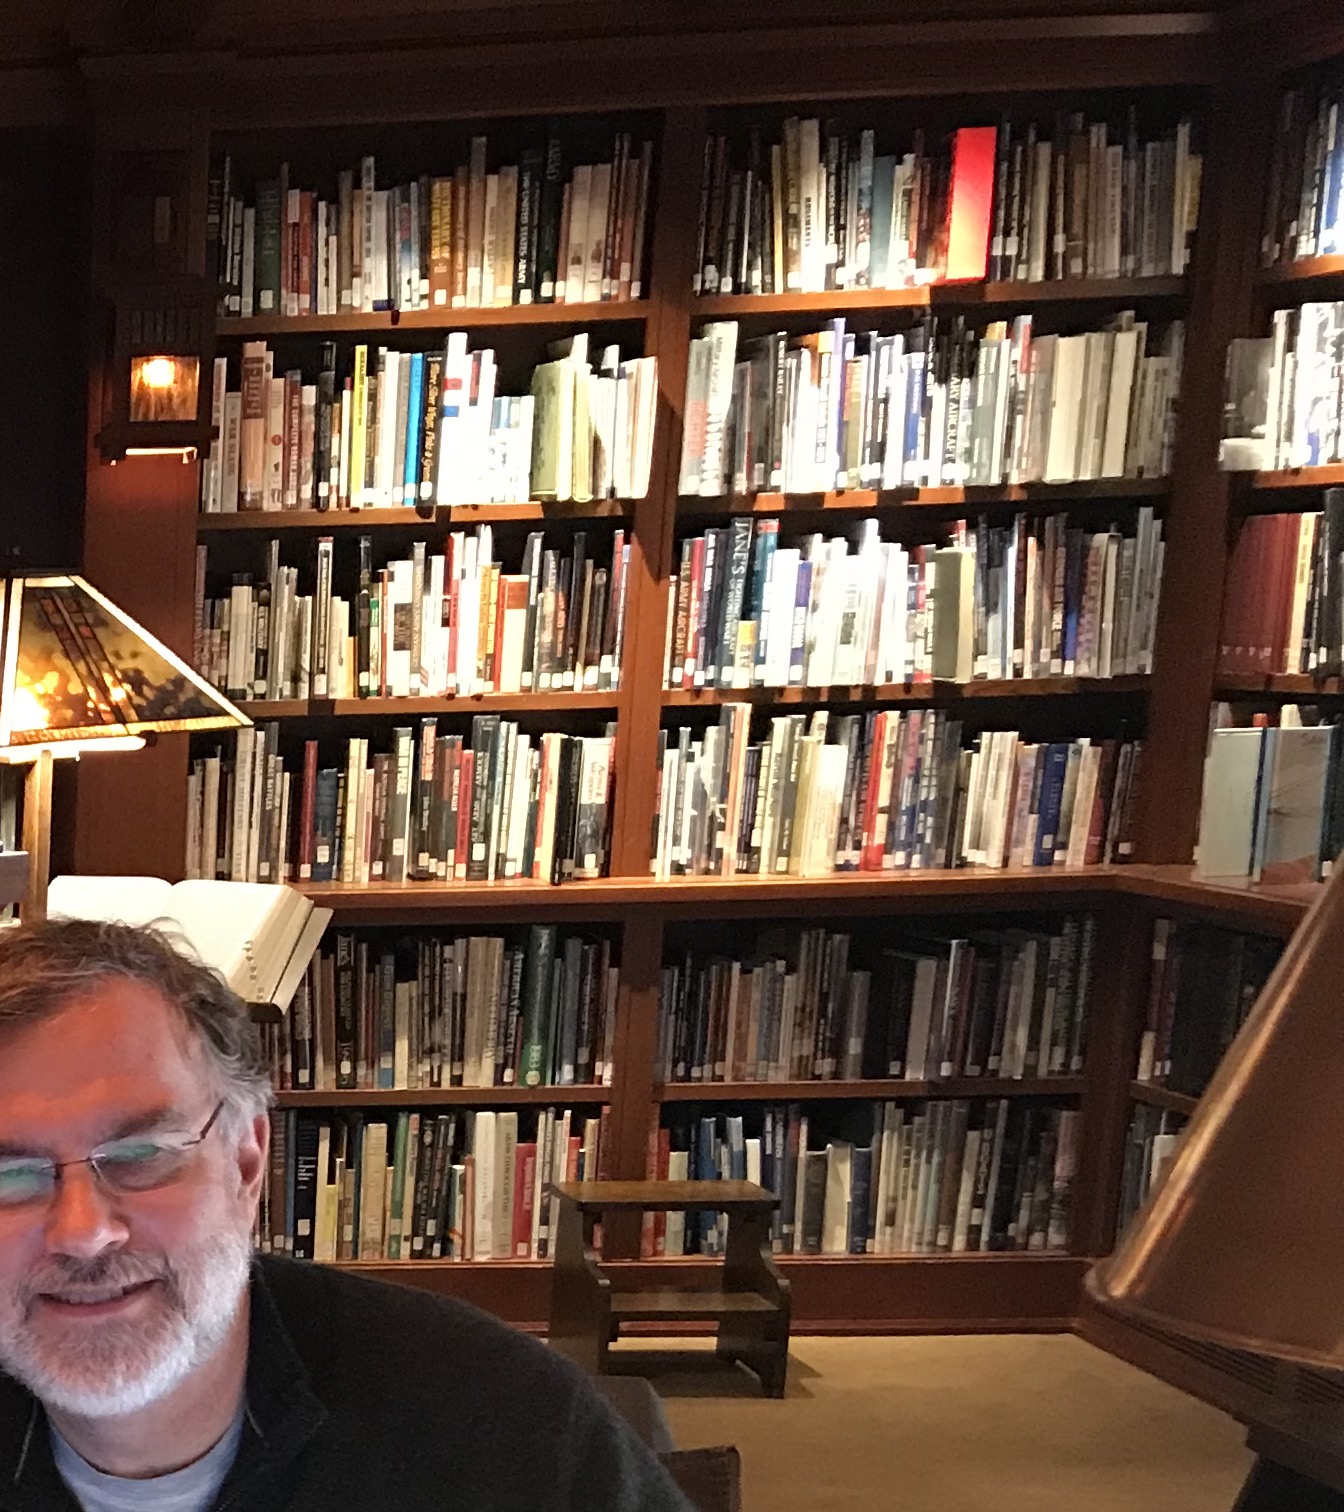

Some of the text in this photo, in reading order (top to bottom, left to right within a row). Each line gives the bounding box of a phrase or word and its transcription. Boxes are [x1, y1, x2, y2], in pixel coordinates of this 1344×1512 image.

[520, 191, 530, 224] UNITED
[519, 226, 528, 256] STATES
[517, 259, 527, 284] ARMY
[945, 402, 958, 460] AIRCRAFT
[732, 522, 749, 574] JANE'S
[676, 562, 690, 654] U.S. ARMY AIRCRAFT
[399, 737, 410, 756] WAR
[265, 780, 273, 810] BATTLES
[396, 768, 408, 795] PEACE
